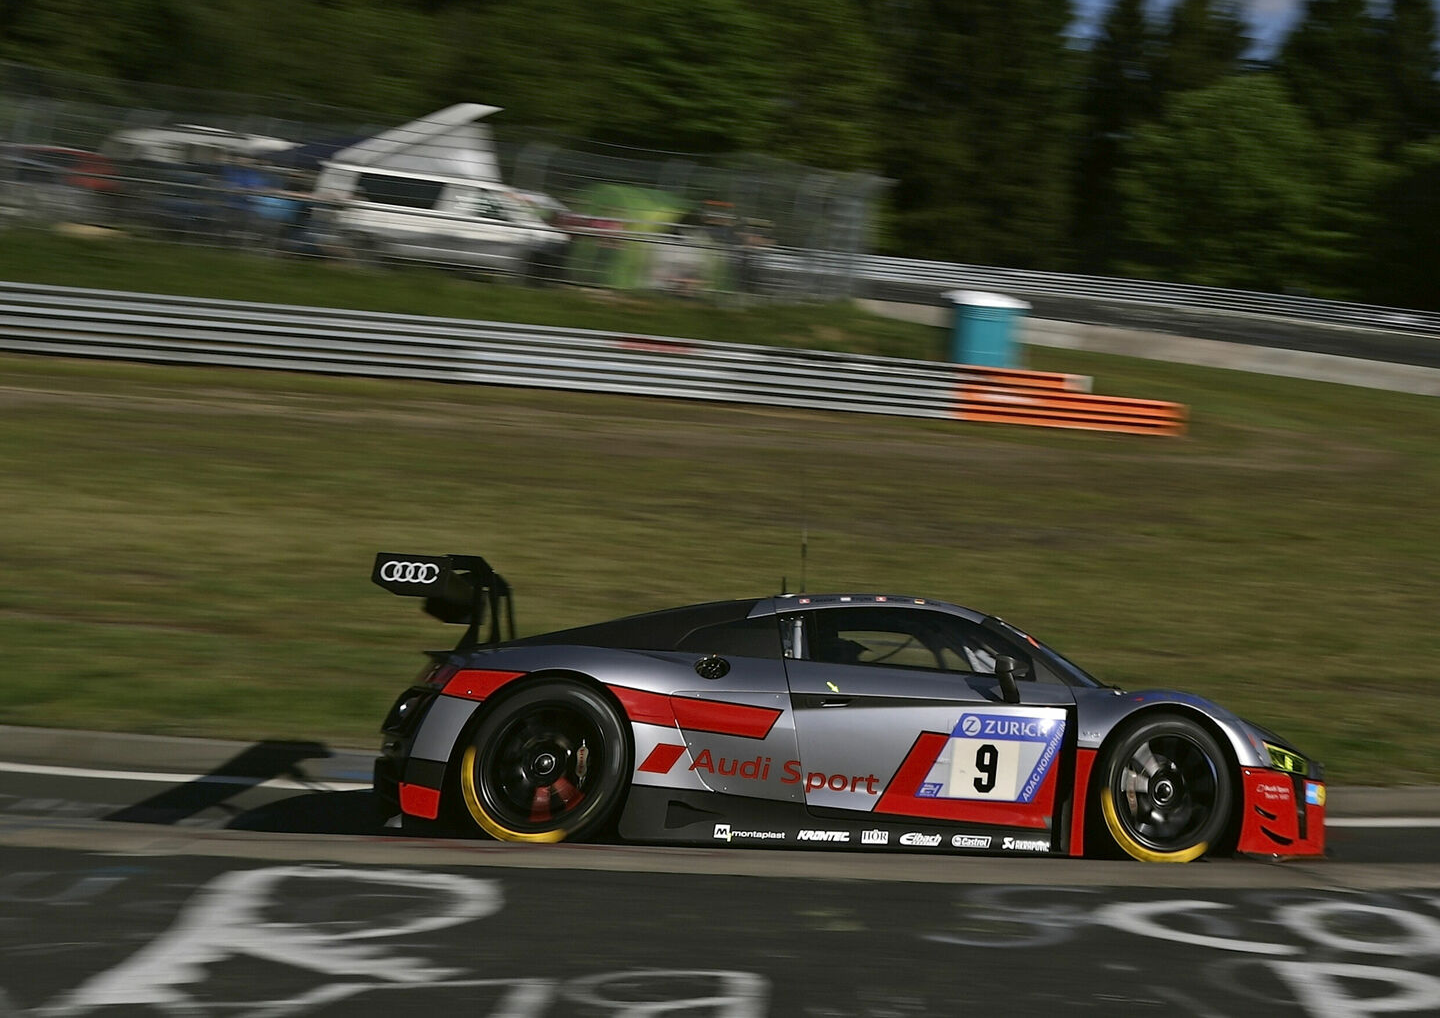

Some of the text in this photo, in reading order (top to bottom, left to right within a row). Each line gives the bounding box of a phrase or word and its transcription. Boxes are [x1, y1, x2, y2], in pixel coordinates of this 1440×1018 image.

[688, 748, 771, 781] Audi
[780, 760, 880, 795] Sport
[973, 744, 999, 793] 9
[1022, 776, 1041, 802] ADAC
[731, 830, 786, 840] montaplast
[797, 830, 850, 842] KRONTEC
[900, 833, 942, 845] Eibach
[962, 838, 987, 847] Castrol
